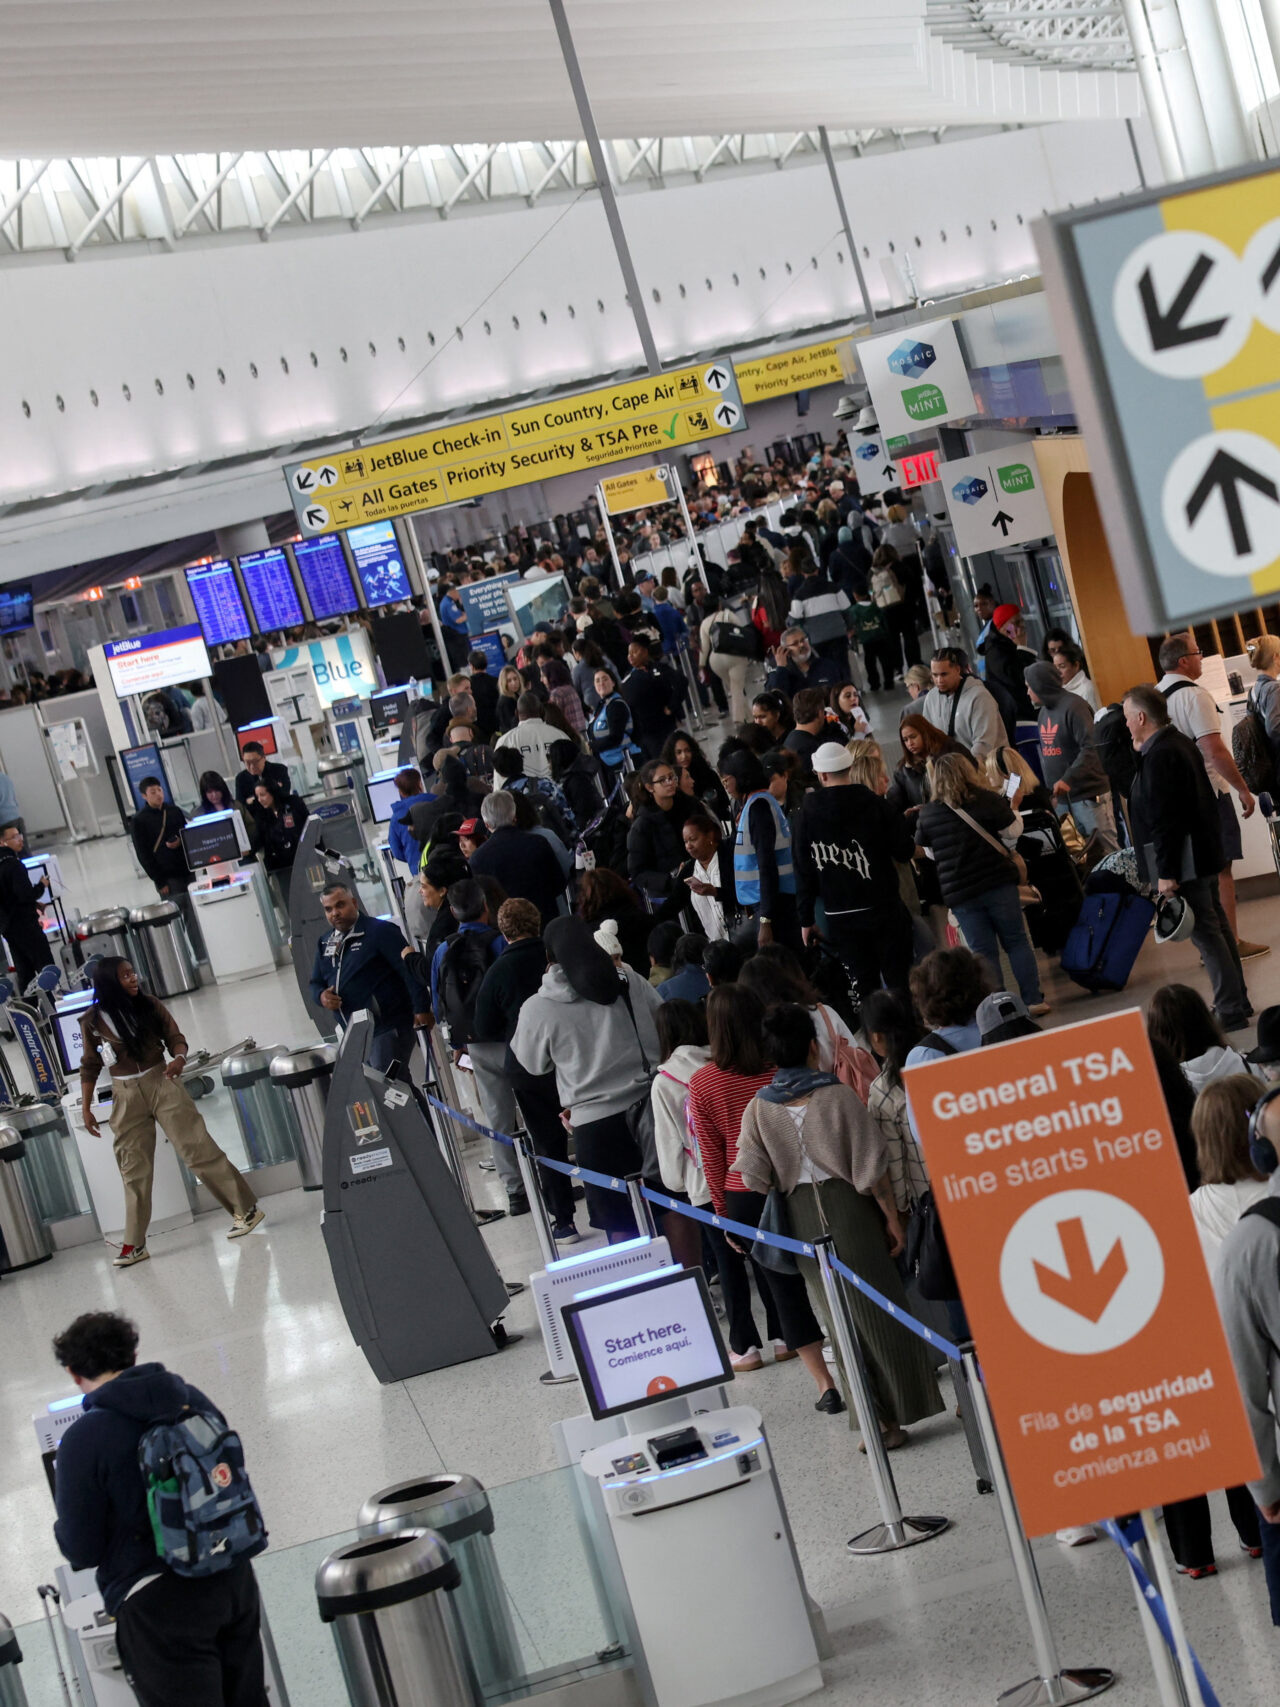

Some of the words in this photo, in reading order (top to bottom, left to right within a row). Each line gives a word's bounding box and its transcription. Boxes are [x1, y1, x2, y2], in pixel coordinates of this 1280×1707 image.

[735, 367, 764, 379] untry,
[766, 359, 789, 371] Cape
[809, 347, 837, 361] JetBlu
[891, 350, 932, 367] MOSAIC
[754, 376, 789, 392] Priority
[790, 367, 828, 383] Security
[511, 421, 540, 437] Sun
[543, 405, 608, 429] Country,
[611, 392, 649, 412] Cape
[654, 384, 675, 401] Air
[908, 397, 941, 415] MINT
[370, 447, 428, 473] JetBlue
[432, 428, 501, 456] Check-in
[446, 460, 506, 485] Priority
[510, 441, 575, 470] Security
[580, 437, 593, 452] &
[595, 428, 629, 449] TSA
[633, 423, 659, 438] Pre
[585, 447, 624, 464] Seguridad
[901, 451, 938, 485] EXIT
[1002, 474, 1029, 489] MINT
[361, 488, 384, 507] All
[388, 477, 438, 500] Gates
[605, 483, 616, 492] All
[616, 479, 638, 489] Gates
[364, 507, 387, 518] Todas
[387, 503, 399, 512] las
[400, 496, 429, 511] puertas
[493, 598, 505, 607] you
[117, 658, 138, 669] Start
[931, 1065, 1057, 1121] General
[1062, 1047, 1134, 1086] TSA
[964, 1096, 1124, 1156] screening
[943, 1170, 998, 1203] line
[1005, 1147, 1088, 1188] starts
[1092, 1127, 1163, 1165] here
[604, 1330, 646, 1354] Start
[647, 1322, 687, 1342] here.
[608, 1345, 664, 1369] Comience
[665, 1335, 693, 1353] aquí.
[1018, 1411, 1060, 1436] Fila
[1064, 1402, 1094, 1425] de
[1098, 1368, 1215, 1416] seguridad
[1069, 1432, 1099, 1454] de
[1103, 1424, 1126, 1445] la
[1128, 1408, 1181, 1437] TSA
[1053, 1446, 1159, 1488] comienza
